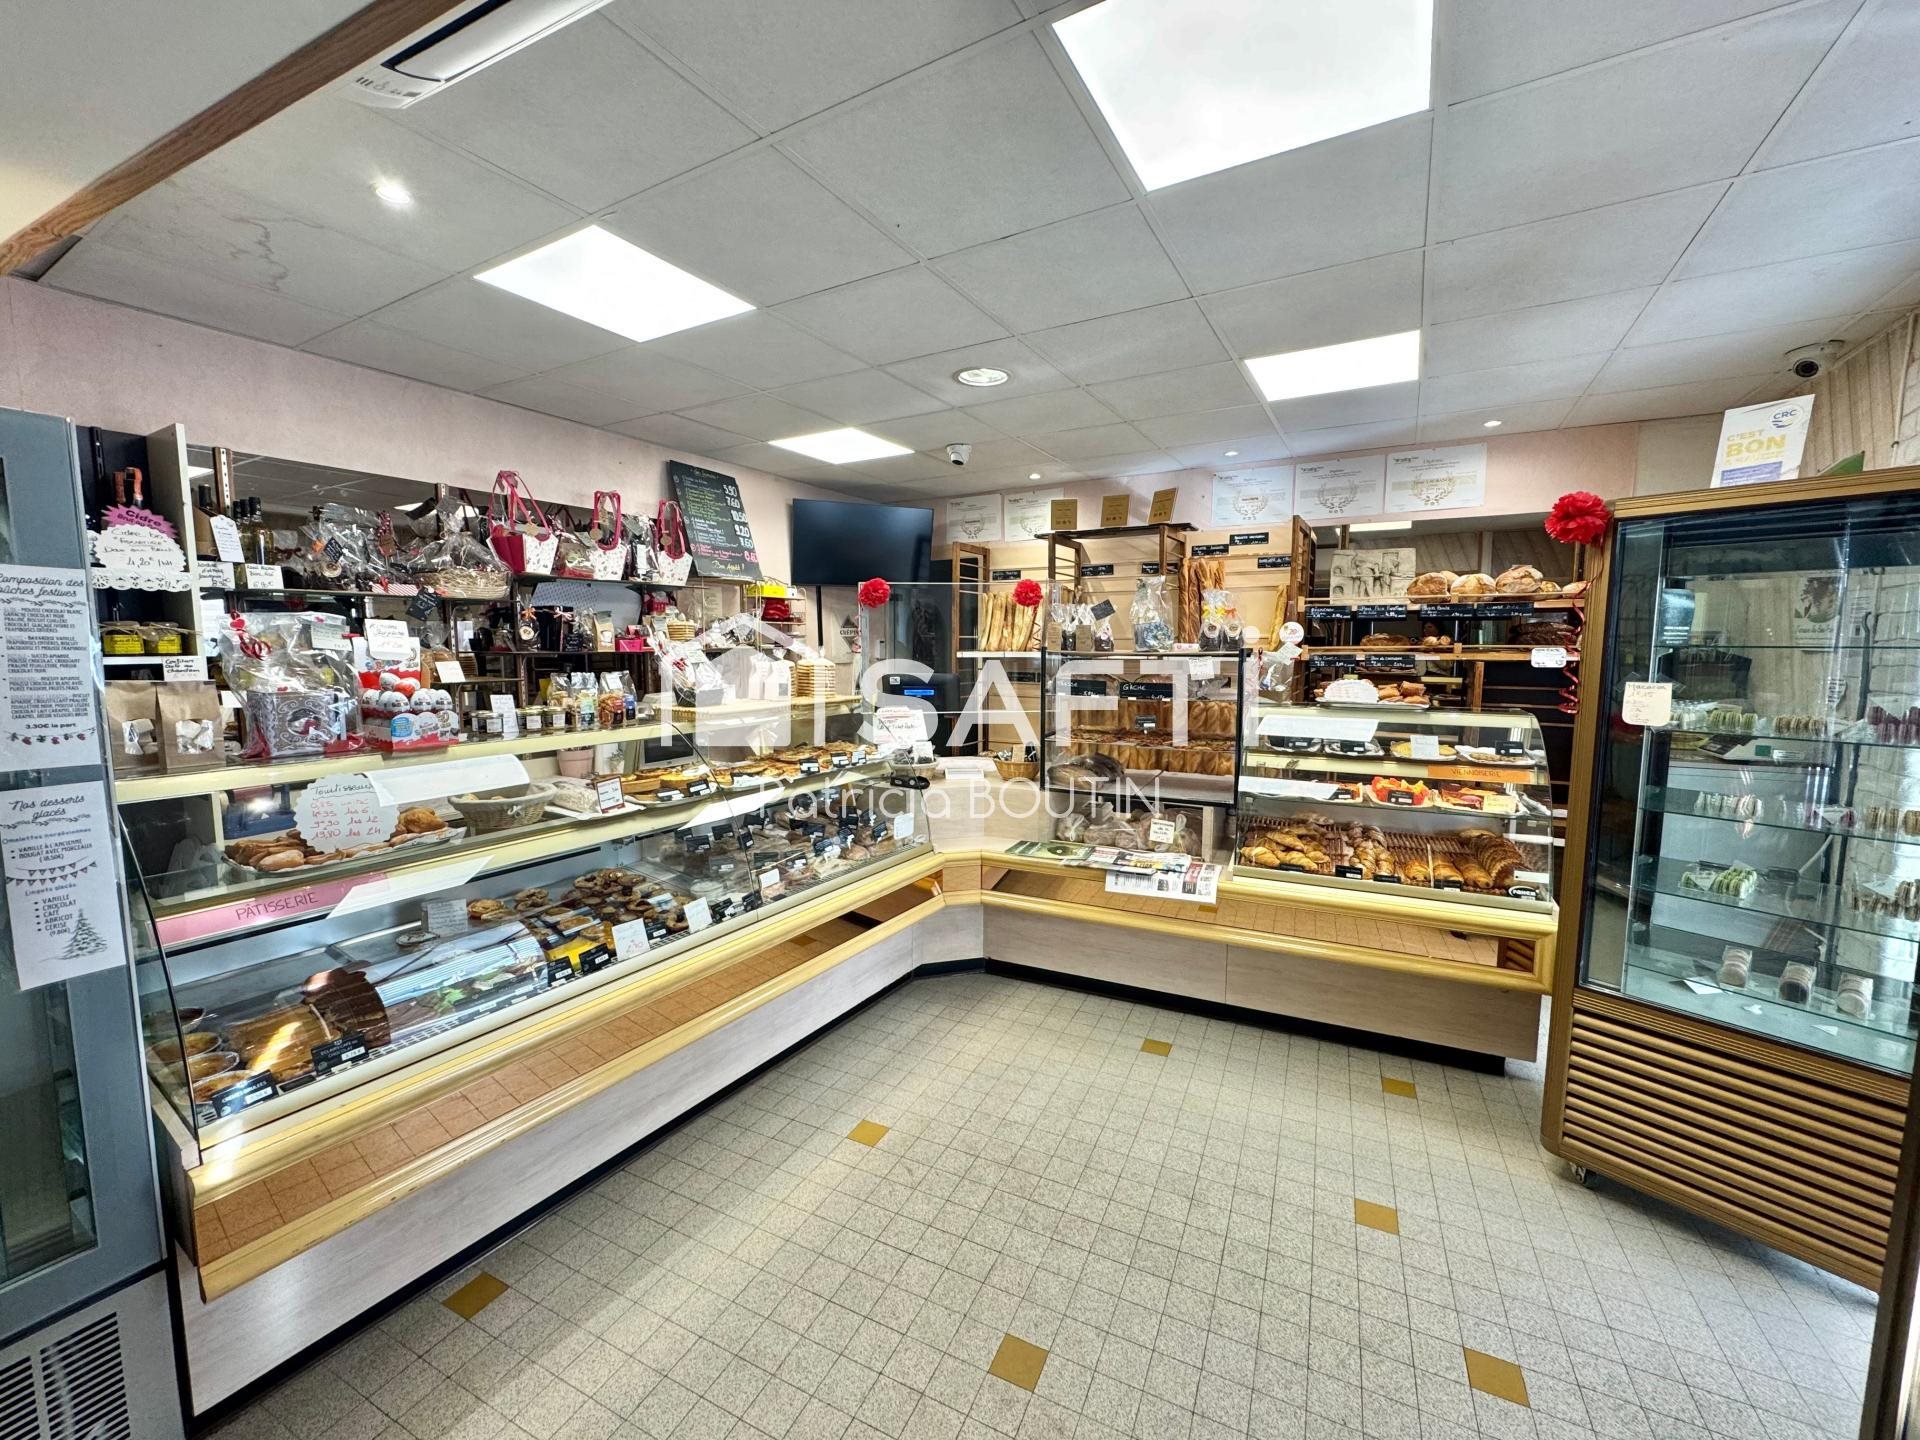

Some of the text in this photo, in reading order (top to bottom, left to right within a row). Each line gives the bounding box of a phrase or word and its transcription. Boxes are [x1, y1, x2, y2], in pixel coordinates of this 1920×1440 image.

[1773, 408, 1797, 420] CRC
[1727, 429, 1765, 441] C'EST
[1727, 434, 1786, 458] BON
[126, 510, 161, 527] Cidre
[65, 577, 84, 586] des
[34, 588, 77, 598] festives
[9, 796, 84, 811] Nos desserts
[32, 808, 66, 822] glacés
[2, 835, 42, 845] Omelettes
[19, 845, 43, 853] VANILLE
[19, 843, 93, 859] NOUGAT AVEC MORCEAUX
[42, 894, 69, 904] VANILLE
[42, 899, 76, 911] CHOCOLAT
[235, 892, 318, 921] PÂTISSERIE
[44, 913, 73, 925] ABRICOT
[45, 921, 67, 932] CERISE
